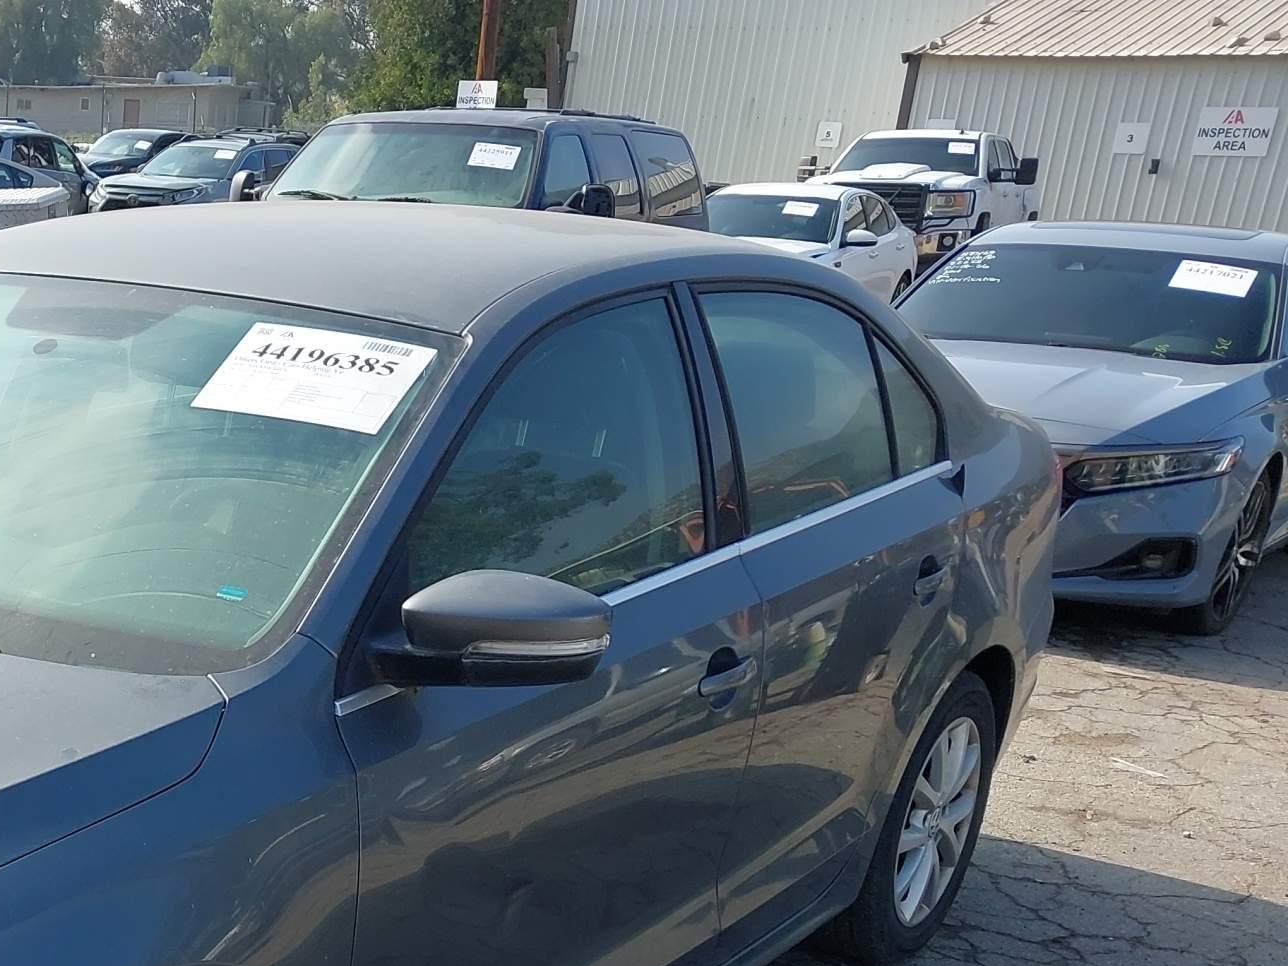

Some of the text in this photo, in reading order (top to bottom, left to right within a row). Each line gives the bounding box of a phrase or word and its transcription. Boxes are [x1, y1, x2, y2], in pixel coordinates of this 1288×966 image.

[458, 96, 495, 105] INSPECTION
[825, 130, 831, 138] 5
[1197, 127, 1270, 139] INSPECTION
[1126, 134, 1134, 143] 3
[1213, 140, 1246, 151] AREA
[252, 342, 400, 377] 44196385
